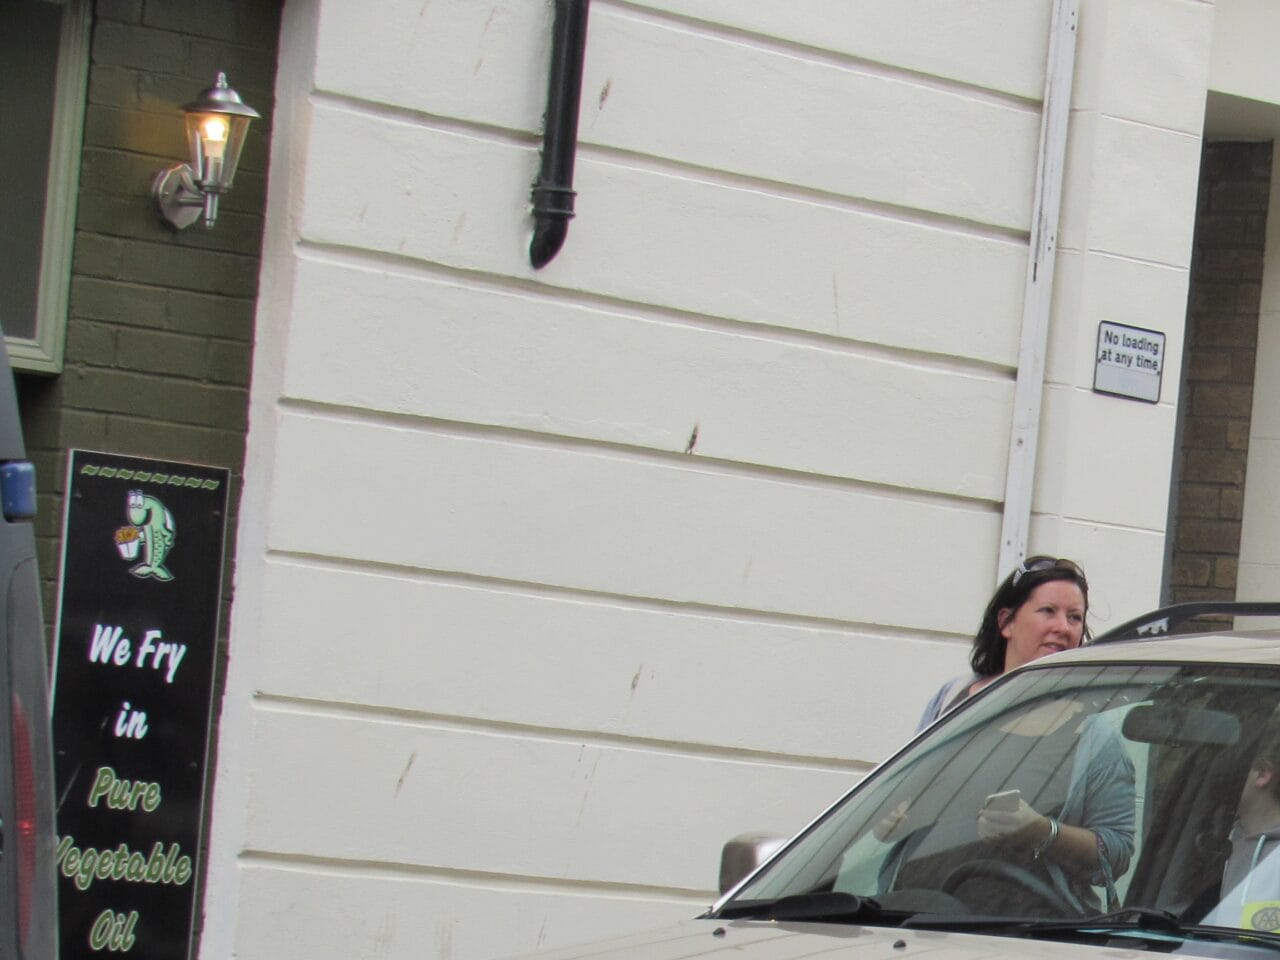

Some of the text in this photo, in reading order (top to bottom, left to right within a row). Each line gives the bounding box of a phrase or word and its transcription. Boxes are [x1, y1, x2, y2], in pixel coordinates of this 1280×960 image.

[1101, 349, 1158, 371] at any time
[1104, 329, 1159, 355] No loading
[89, 624, 187, 683] We Fry
[115, 702, 148, 739] in
[88, 766, 162, 812] Pure
[89, 909, 139, 951] Oil
